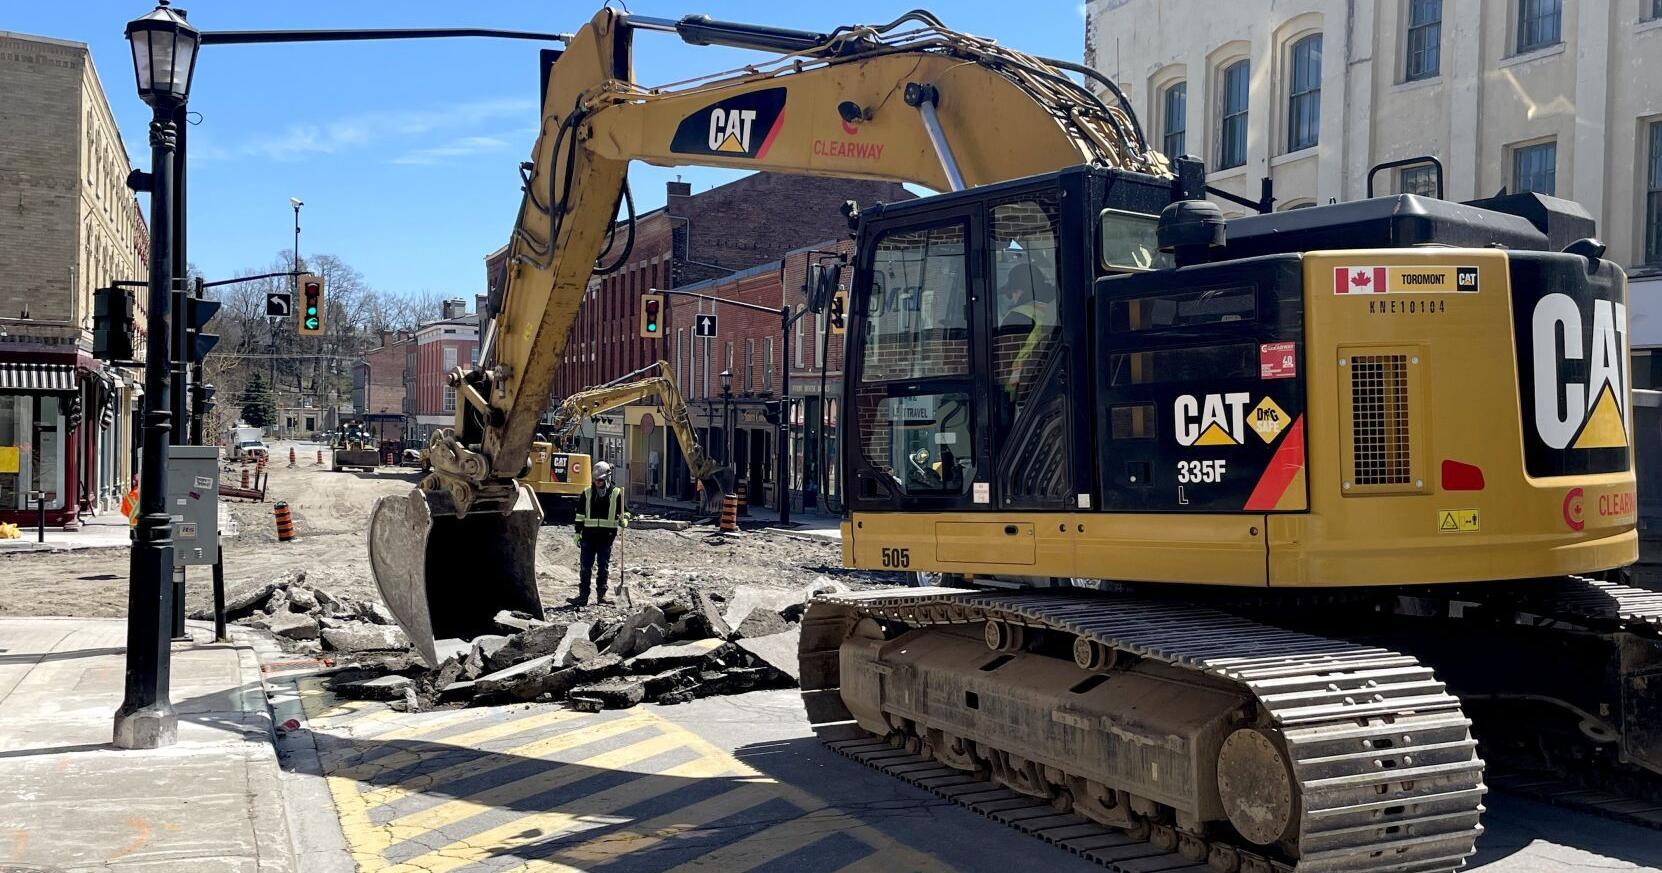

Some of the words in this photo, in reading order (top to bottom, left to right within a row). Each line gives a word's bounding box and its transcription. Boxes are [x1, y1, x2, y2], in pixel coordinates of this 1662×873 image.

[708, 107, 756, 153] CAT
[814, 140, 885, 160] CLEARWAY
[1401, 273, 1446, 285] TOROMONT
[1458, 273, 1477, 286] CAT
[1369, 300, 1445, 314] KNE10104
[1532, 292, 1629, 450] CAT
[907, 408, 928, 418] TRAVEL
[1174, 392, 1249, 447] CAT
[1257, 421, 1280, 433] SAFE
[554, 457, 567, 467] CAT
[1177, 459, 1226, 483] 335F
[1178, 484, 1189, 505] L
[881, 547, 910, 568] 505
